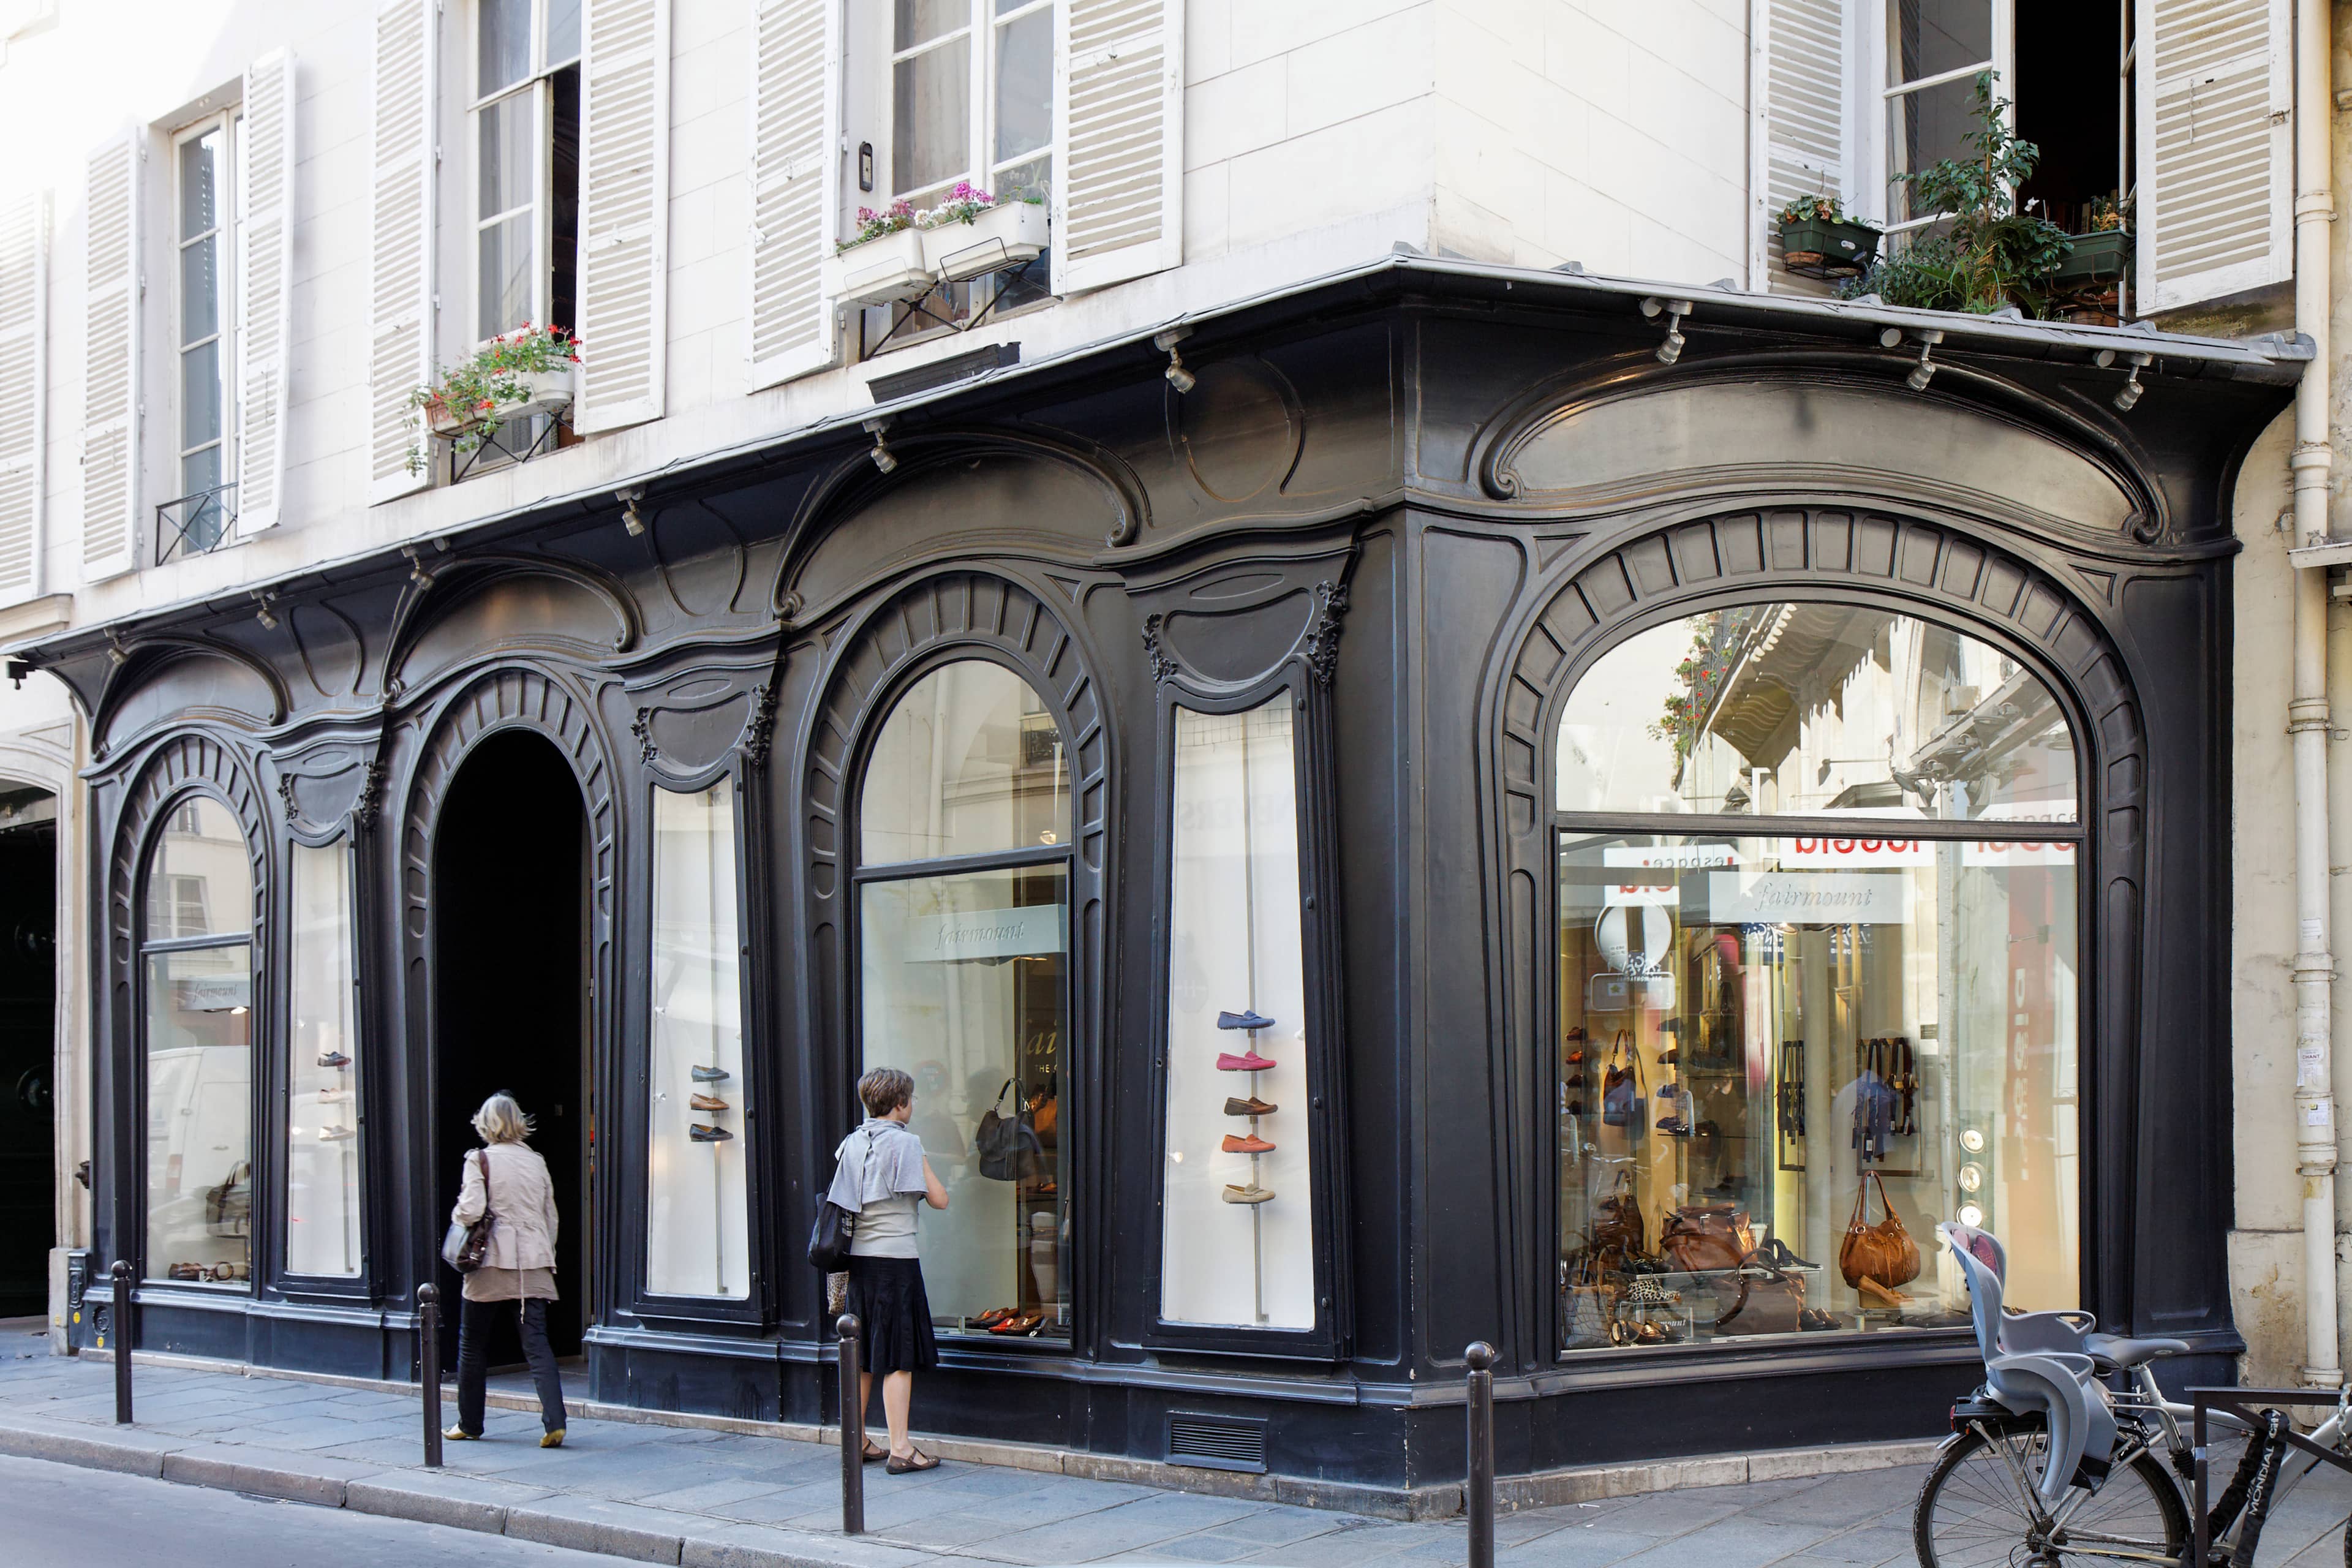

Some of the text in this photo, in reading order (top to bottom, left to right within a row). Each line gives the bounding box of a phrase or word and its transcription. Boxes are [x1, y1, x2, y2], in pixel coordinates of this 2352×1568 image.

[1754, 882, 1873, 912] fairmount
[935, 921, 1025, 951] fairmount
[193, 982, 238, 1003] fairmount
[2248, 1446, 2275, 1516] MONDIAL
[2268, 1409, 2282, 1439] City
